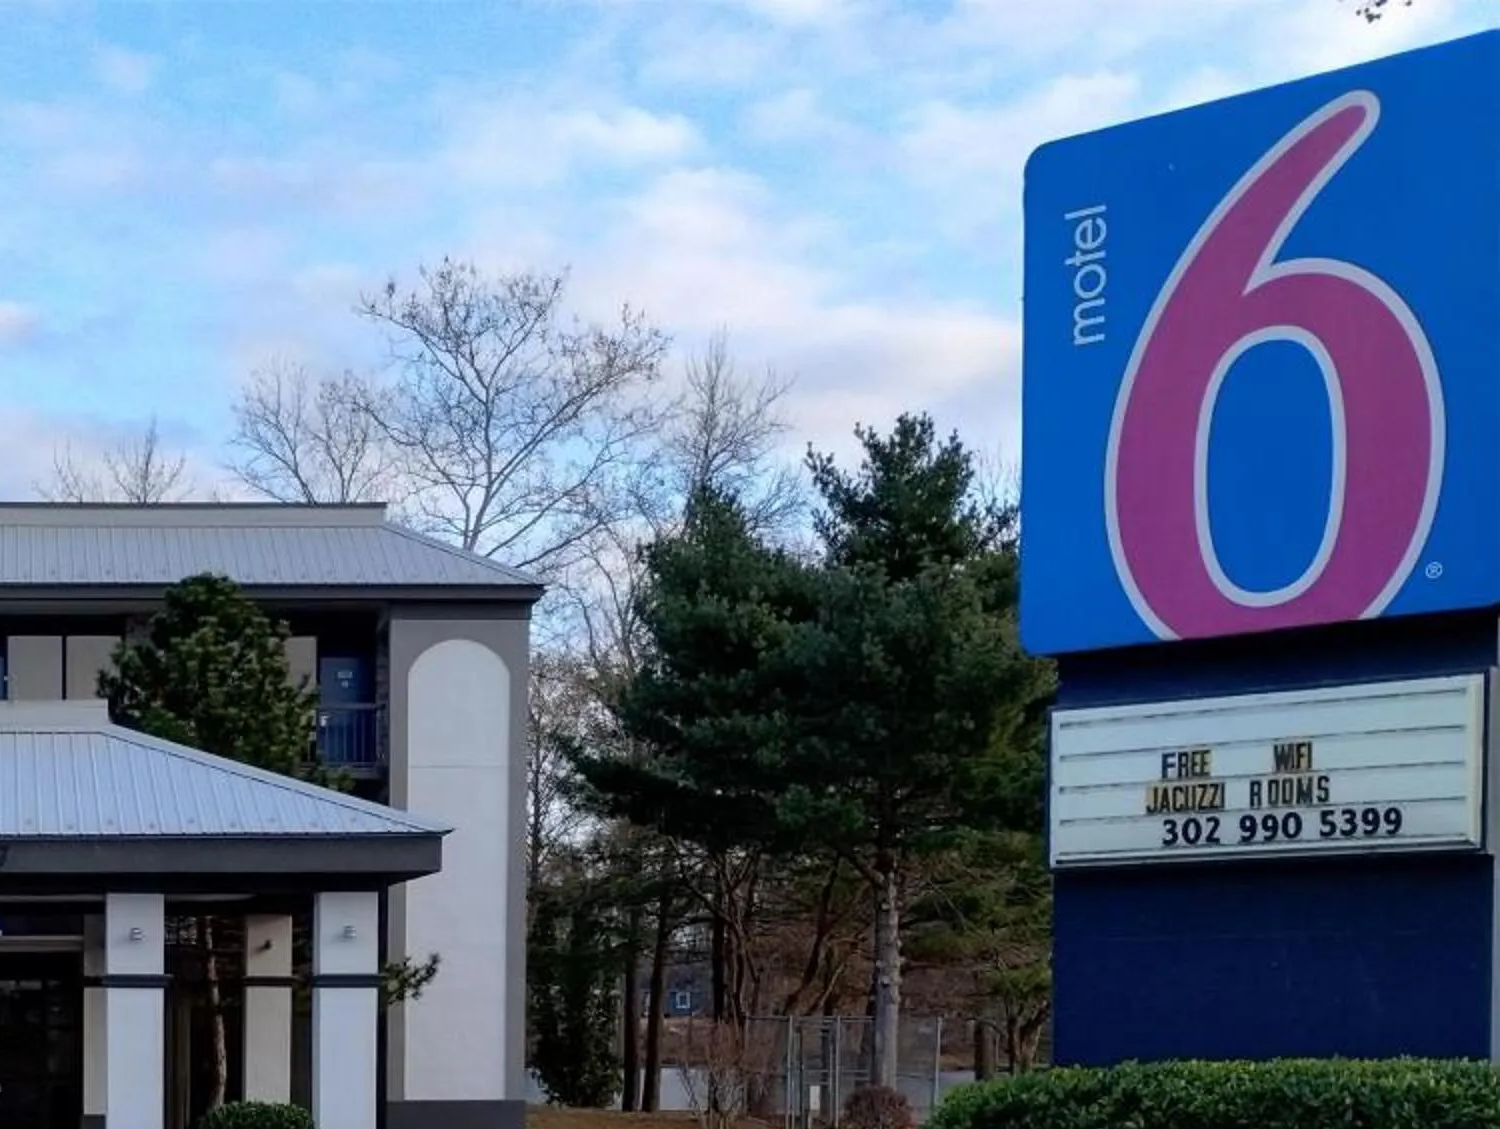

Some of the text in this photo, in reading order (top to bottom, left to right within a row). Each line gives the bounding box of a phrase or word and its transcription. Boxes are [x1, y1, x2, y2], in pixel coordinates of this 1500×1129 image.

[1064, 89, 1446, 640] motel 6
[1161, 741, 1313, 779] FREE WIFI
[1146, 775, 1331, 813] JACUZZI ROOMS
[1162, 807, 1403, 846] 302 990 5399
